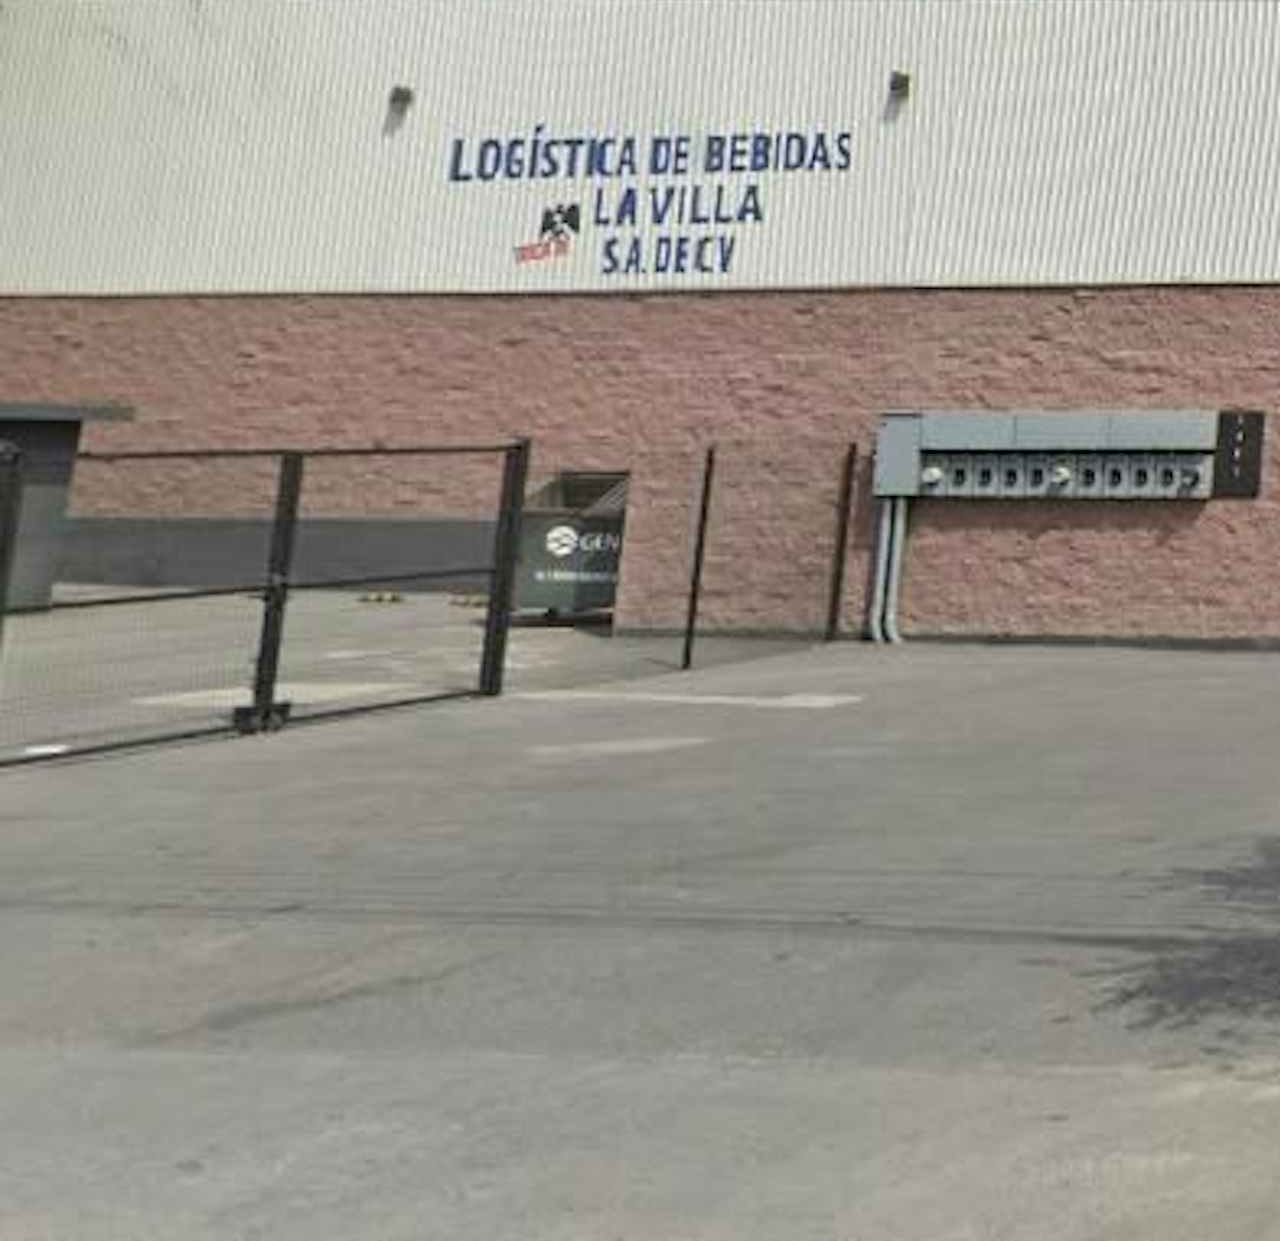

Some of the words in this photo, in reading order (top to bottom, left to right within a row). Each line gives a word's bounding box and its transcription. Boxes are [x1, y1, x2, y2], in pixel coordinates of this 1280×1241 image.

[449, 124, 636, 182] LOGÍSTICA
[649, 136, 691, 175] DE
[704, 132, 852, 173] BEBIDAS
[594, 187, 637, 226] LA
[649, 184, 764, 224] VILLA
[655, 236, 691, 273] DE
